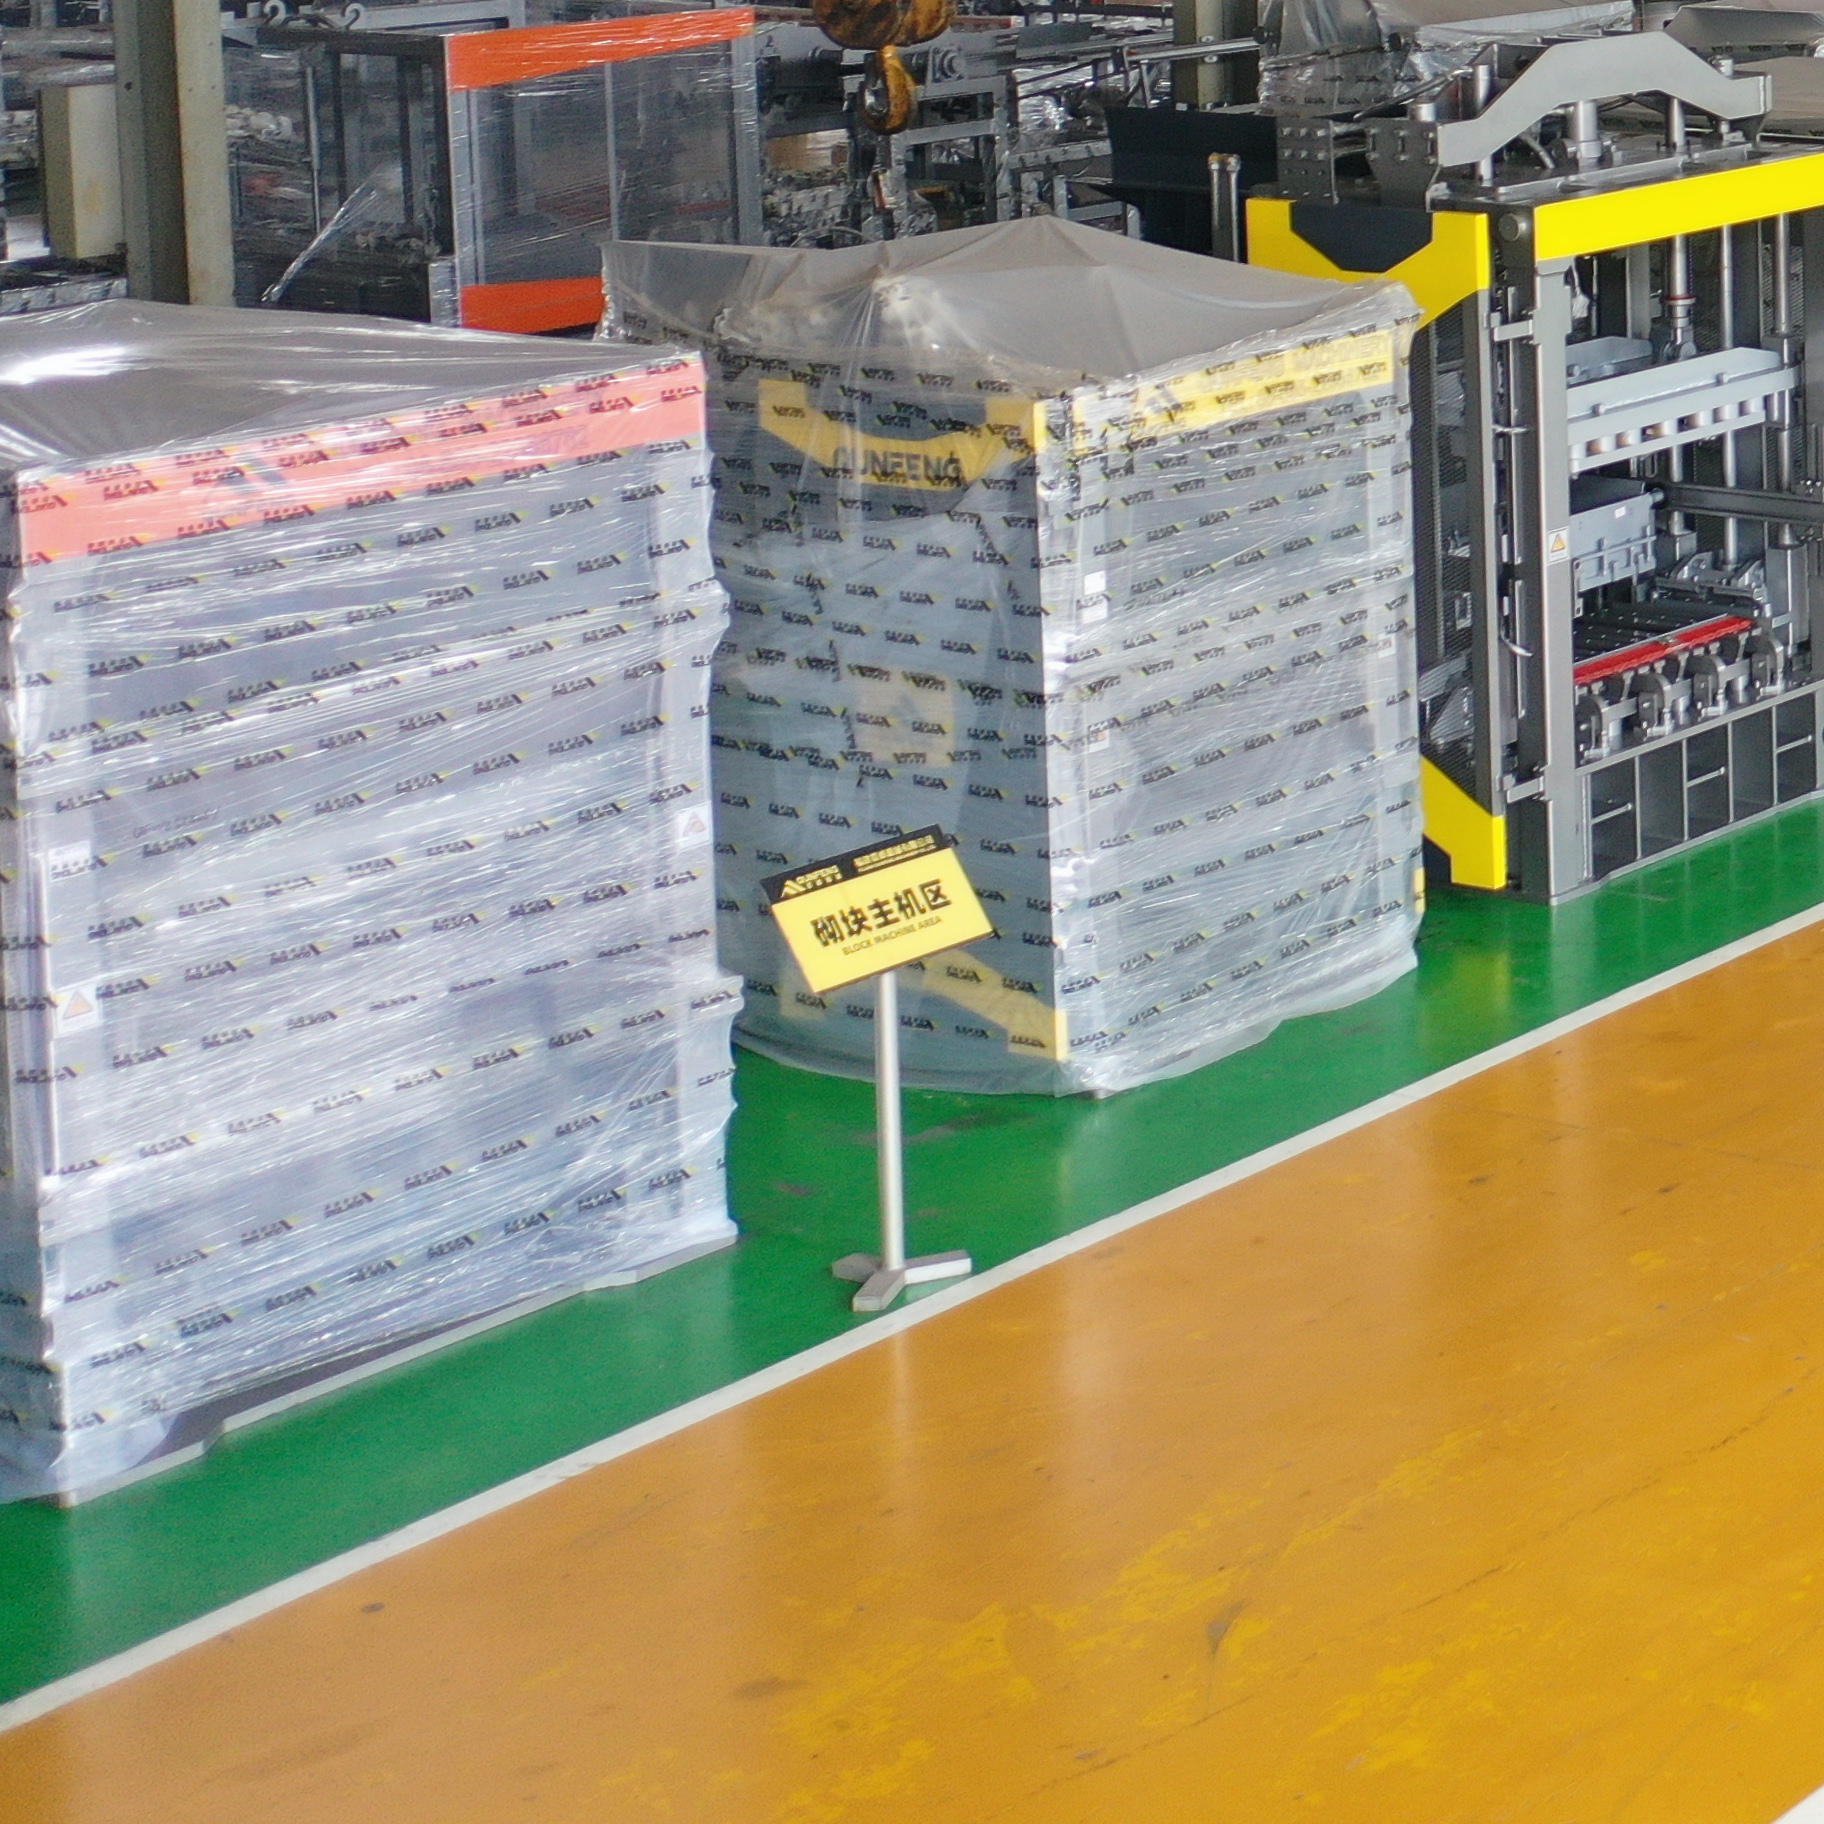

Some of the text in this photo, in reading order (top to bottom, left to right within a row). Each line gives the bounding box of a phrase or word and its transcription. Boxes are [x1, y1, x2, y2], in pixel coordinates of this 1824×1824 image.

[811, 878, 952, 947] 砌块主机区
[843, 915, 943, 956] BLOCK MACHINE AREA
